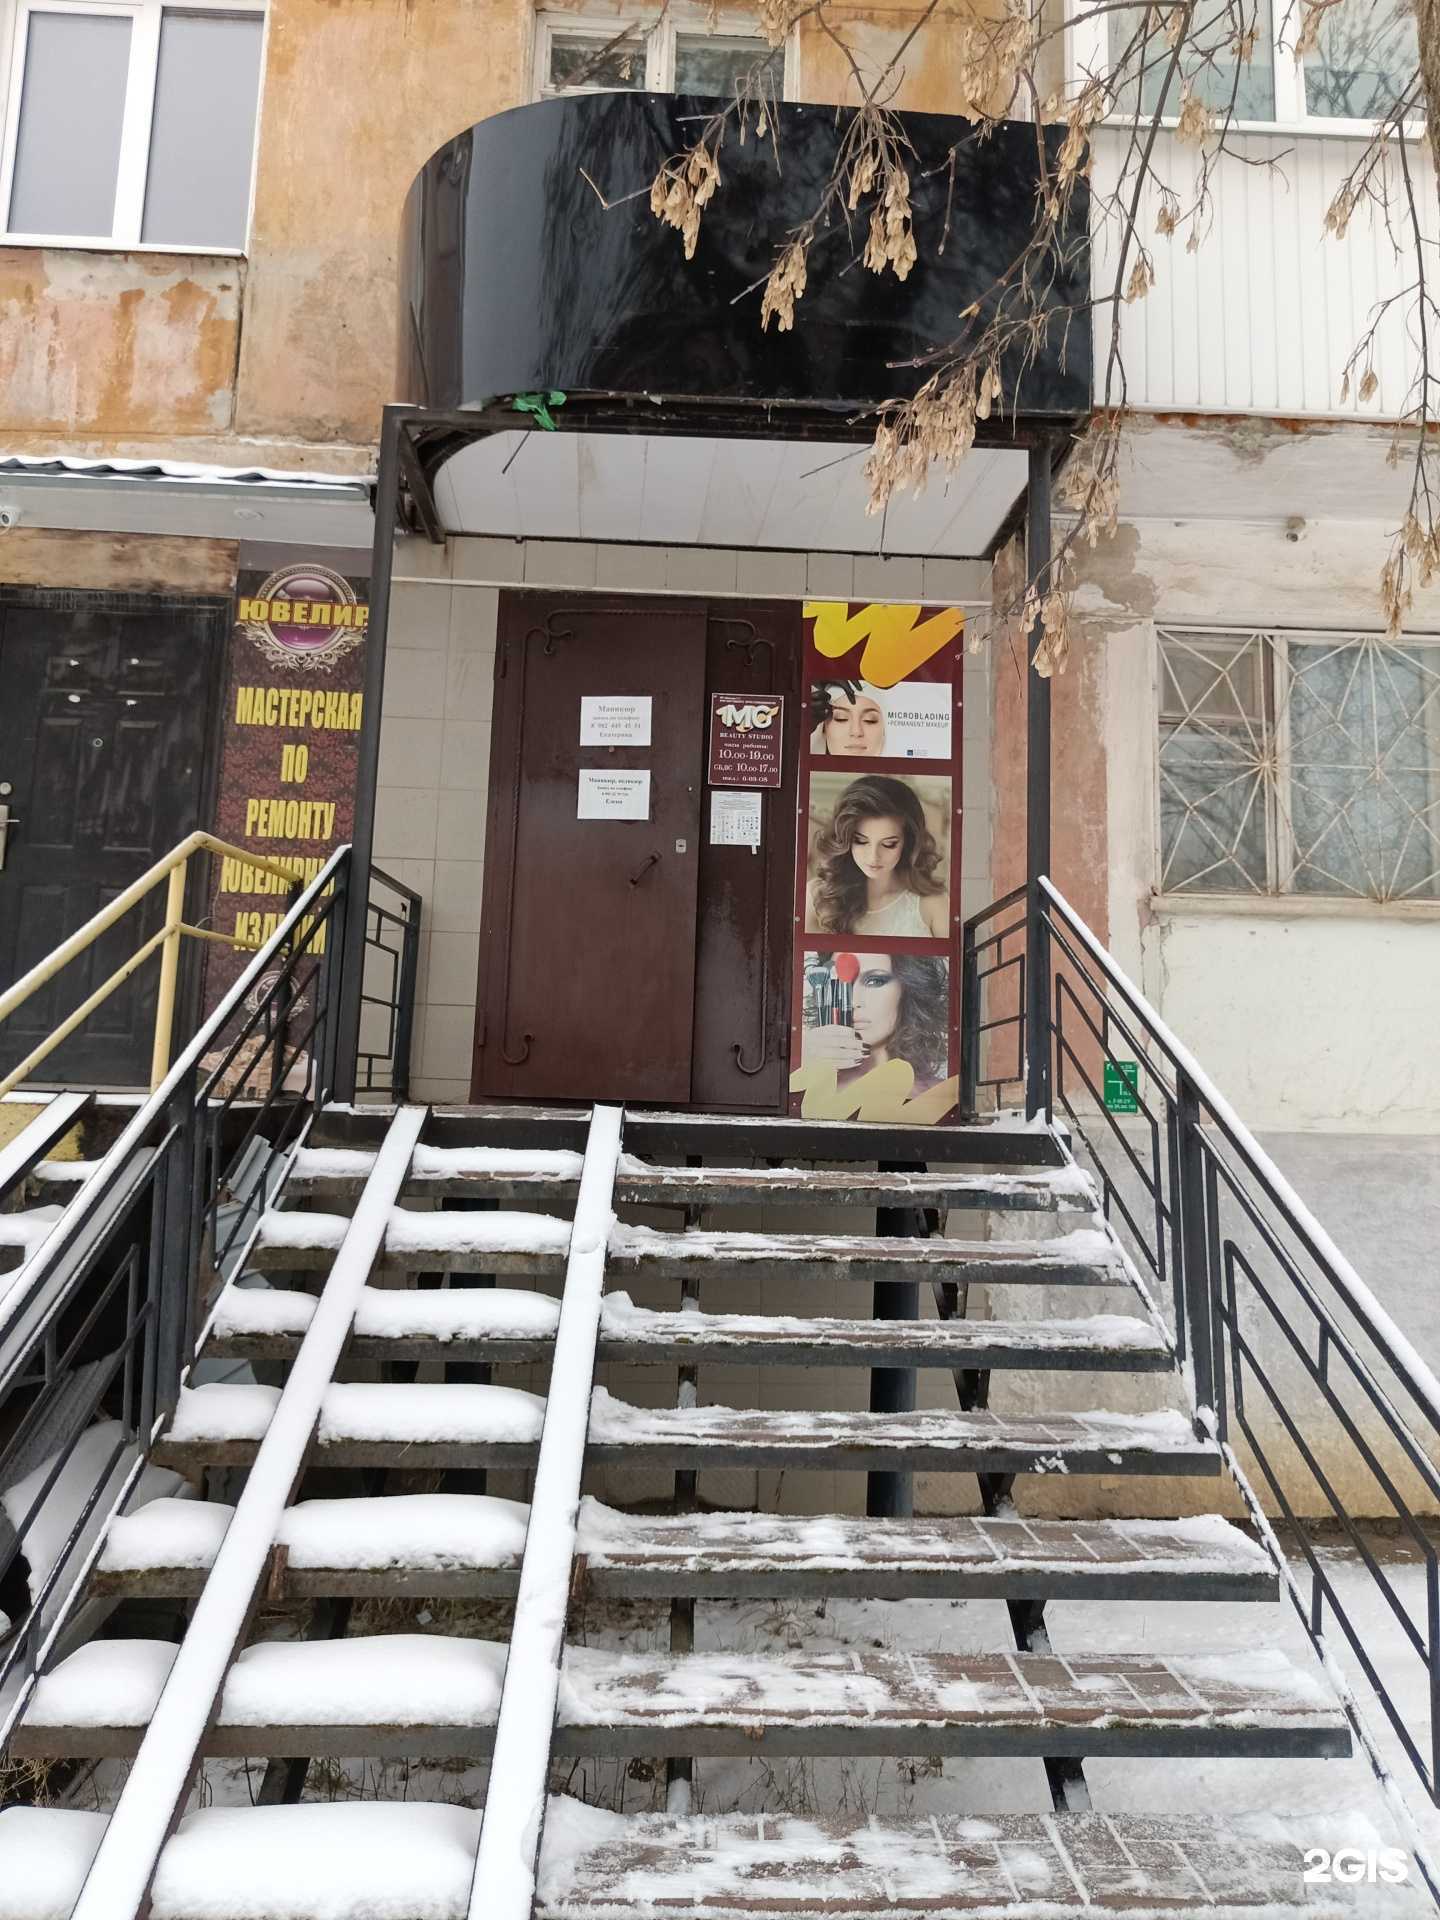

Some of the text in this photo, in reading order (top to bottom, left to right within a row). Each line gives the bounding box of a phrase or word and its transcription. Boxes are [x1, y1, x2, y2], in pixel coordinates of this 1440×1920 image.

[239, 598, 369, 627] ЮВЕЛИР
[235, 686, 364, 731] МАСТЕРСКАЯ
[887, 711, 950, 721] MICROBLADING
[280, 744, 309, 784] ПО
[244, 798, 336, 840] РЕМОНТУ
